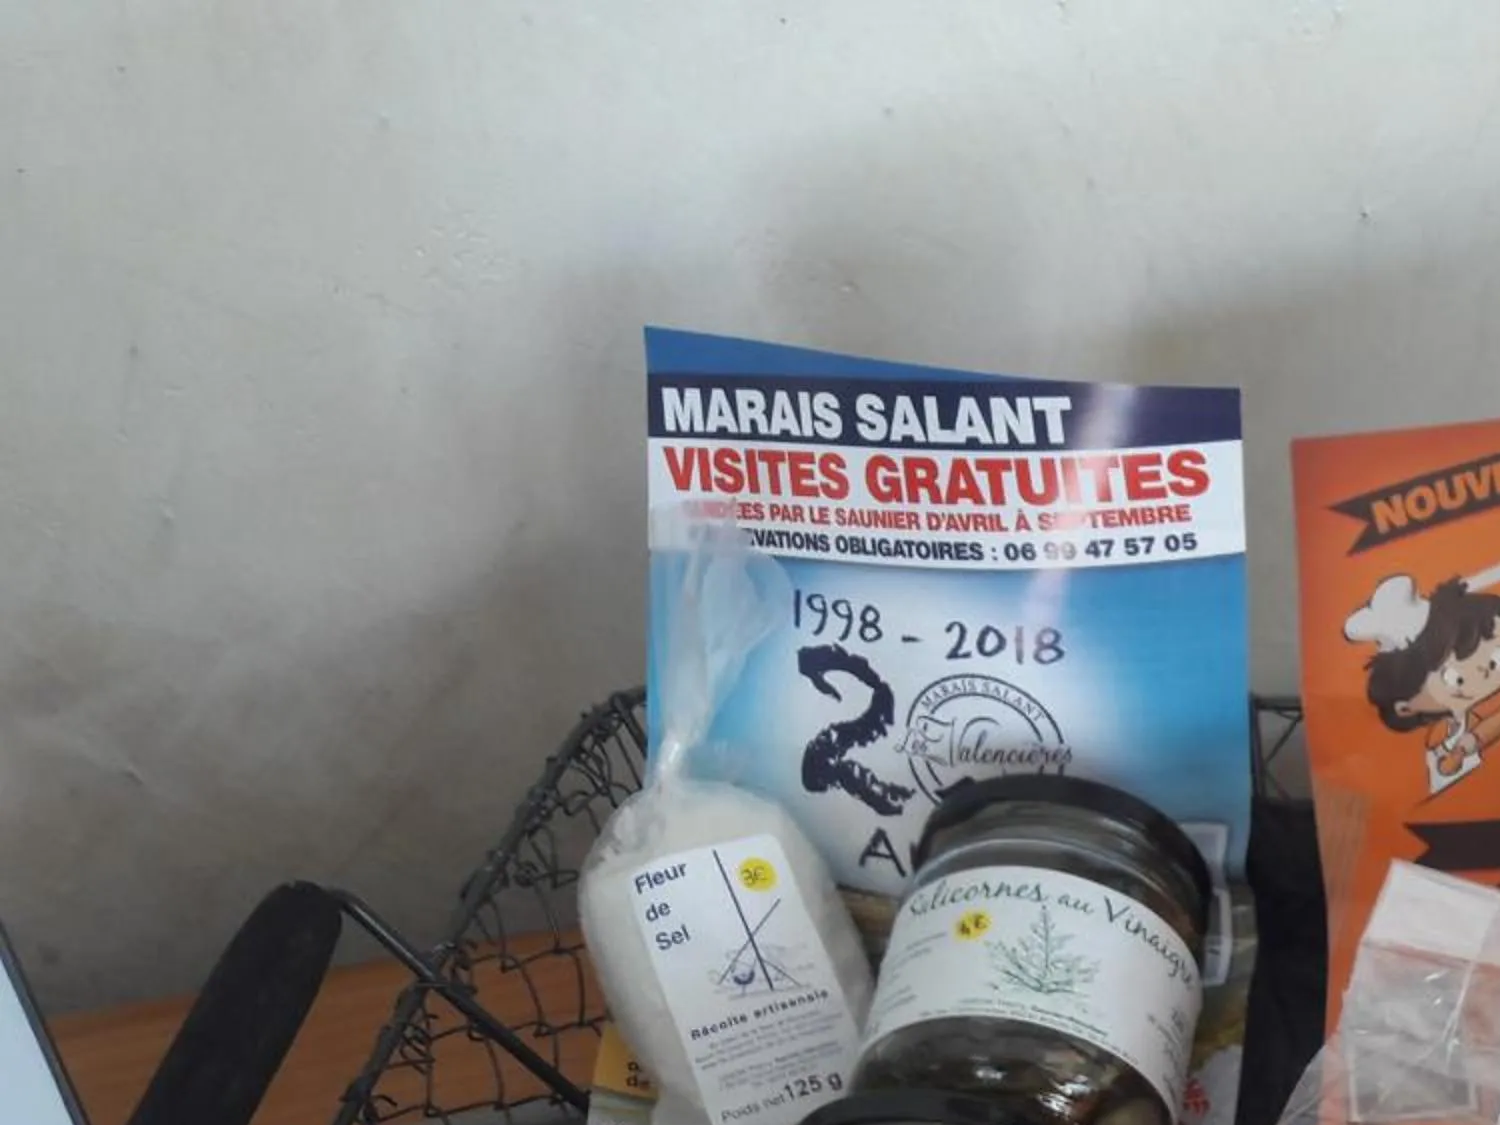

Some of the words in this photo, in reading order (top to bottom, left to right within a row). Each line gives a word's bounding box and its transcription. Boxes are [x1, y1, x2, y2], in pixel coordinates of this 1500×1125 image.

[661, 387, 843, 440] MARAIS
[856, 393, 1072, 445] SALANT
[662, 446, 850, 500] VISITES
[865, 450, 1210, 506] GRATUITES
[770, 505, 806, 524] PAR
[810, 506, 831, 524] LE
[834, 508, 920, 531] SAUNIER
[927, 511, 1009, 532] D'AVRIL
[1015, 508, 1032, 531] À
[1038, 504, 1193, 531] STEMBRE
[835, 535, 985, 561] OBLIGATOIRES
[1003, 542, 1037, 562] 06
[1085, 539, 1115, 559] 47
[1124, 536, 1156, 556] 57
[1164, 532, 1197, 553] 05
[794, 590, 882, 643] 1998
[945, 621, 1066, 666] 2018
[634, 861, 688, 895] Fleur
[645, 901, 672, 922] de
[1057, 892, 1095, 915] au
[656, 924, 691, 951] Sel
[784, 1075, 822, 1100] 125
[828, 1072, 843, 1091] g
